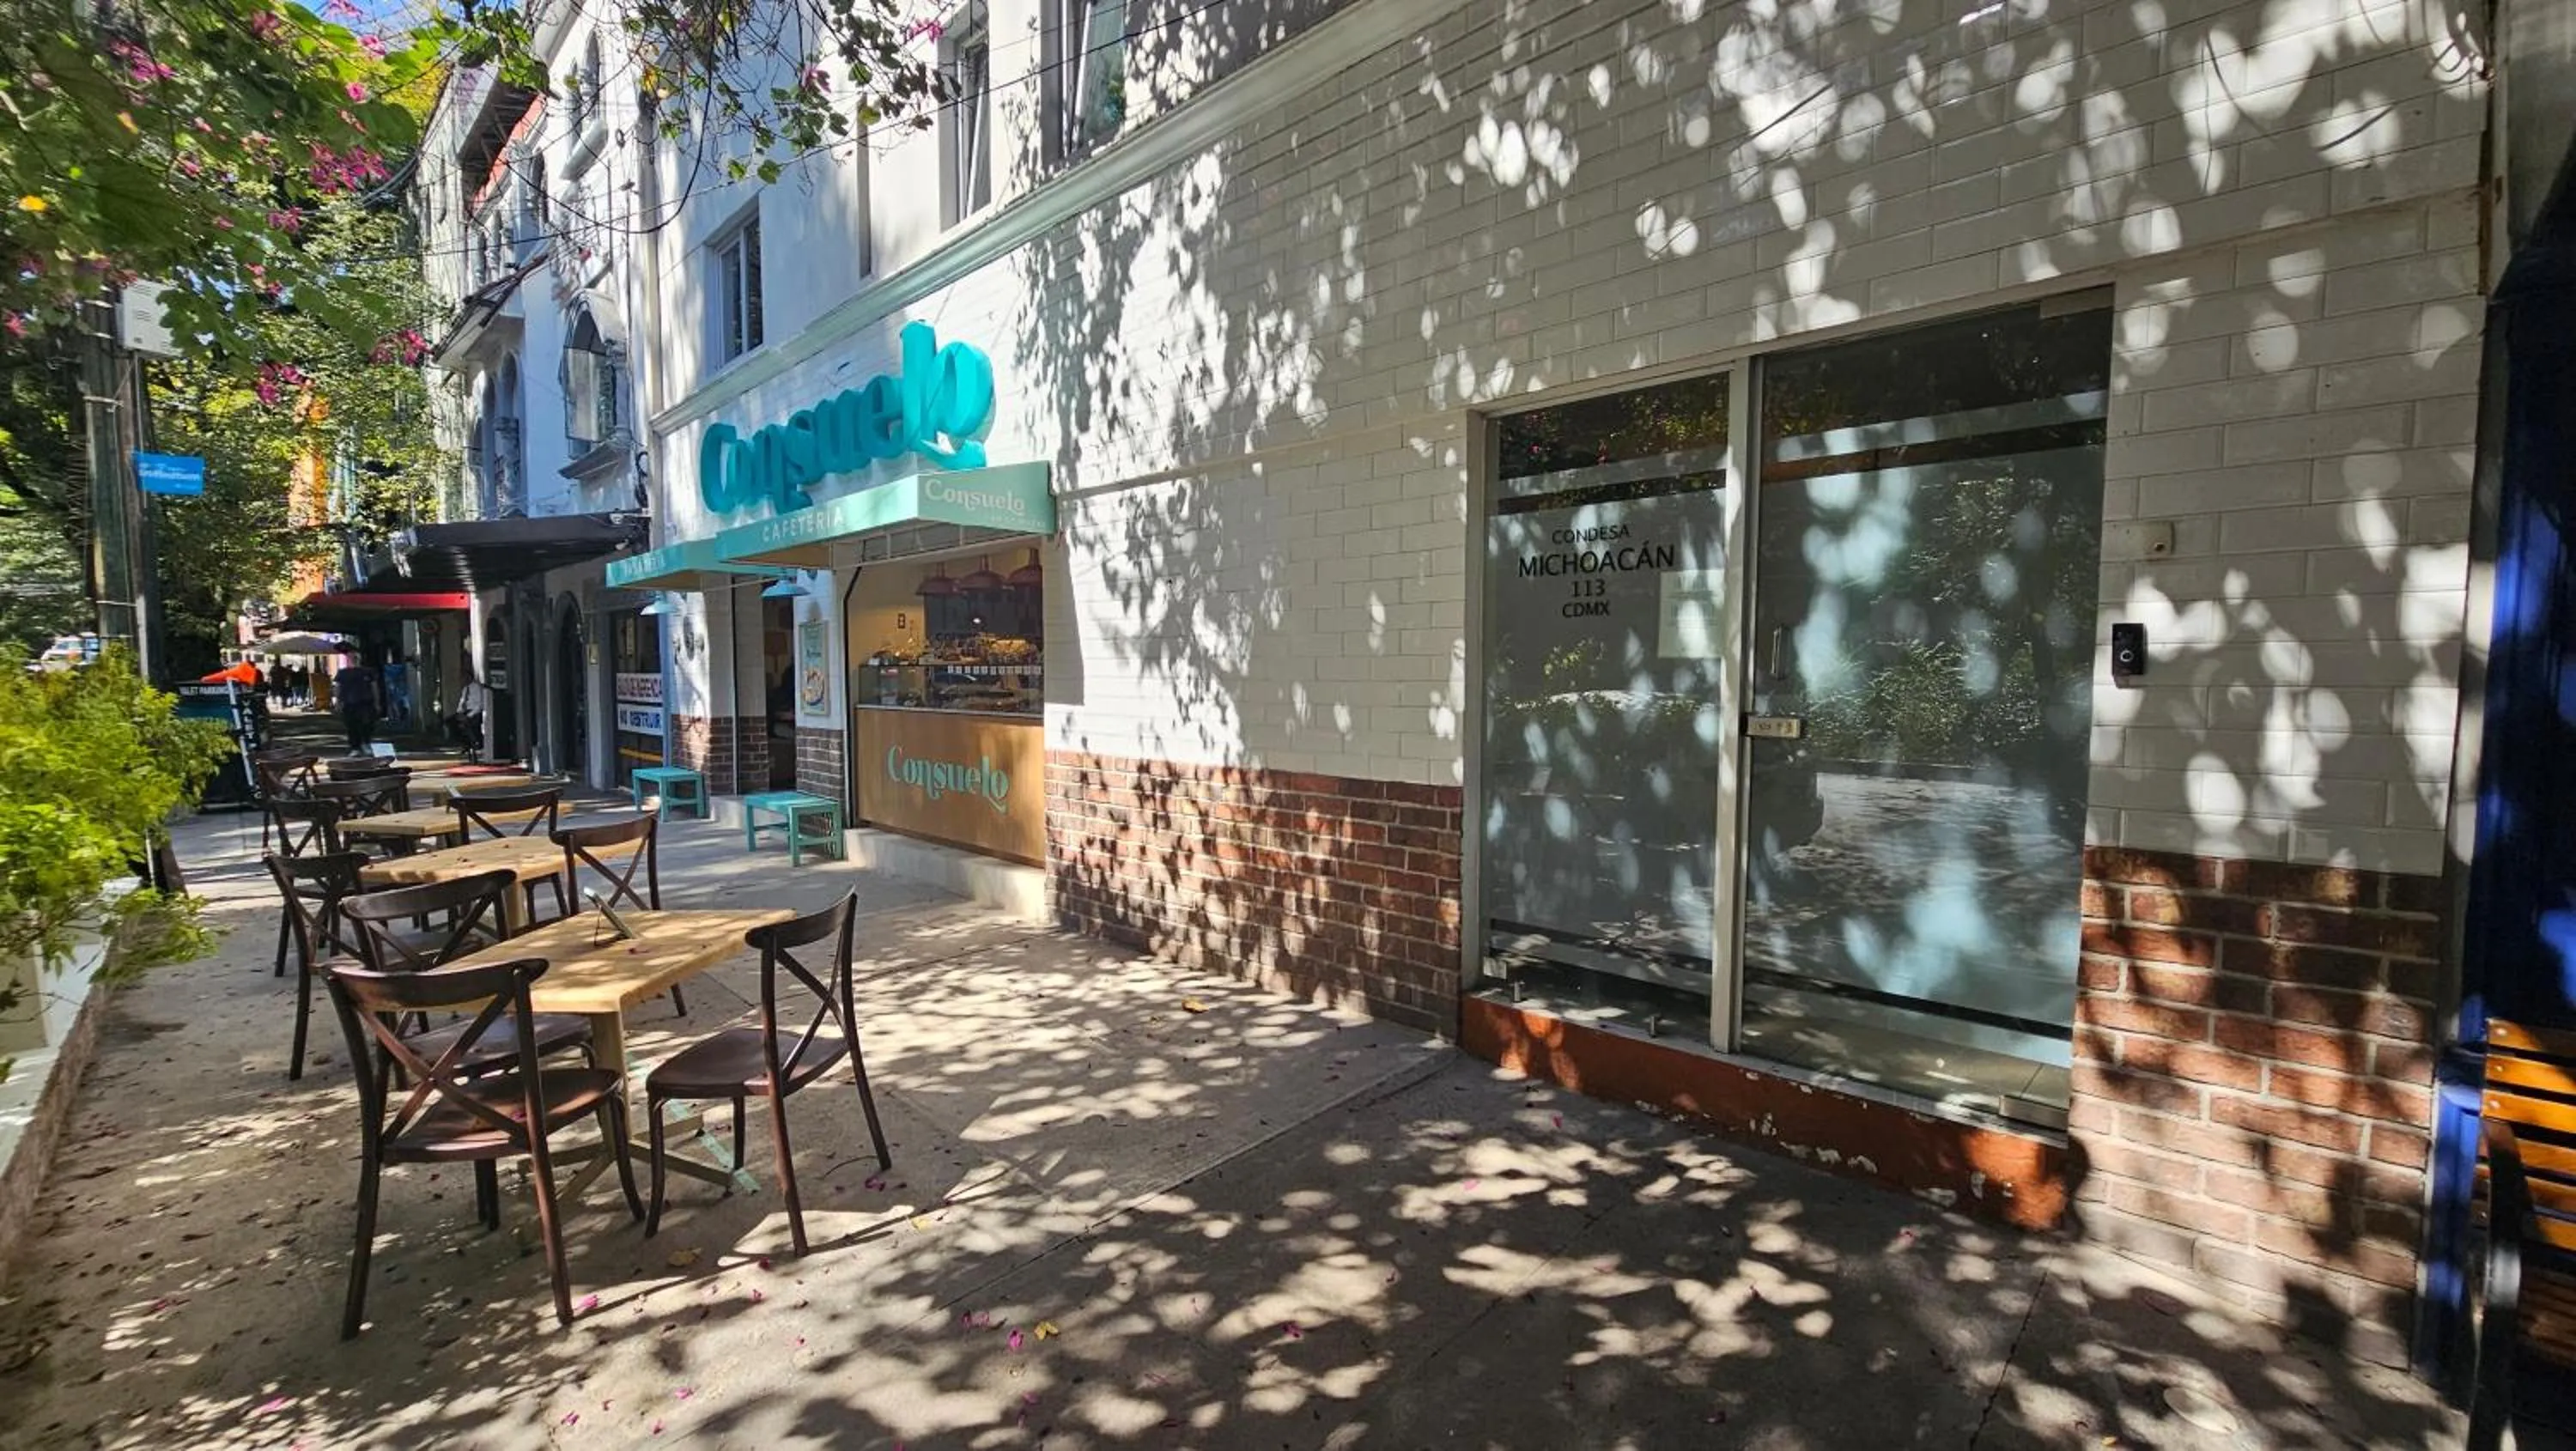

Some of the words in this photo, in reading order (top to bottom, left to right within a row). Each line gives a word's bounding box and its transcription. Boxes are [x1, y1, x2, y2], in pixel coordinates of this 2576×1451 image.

[701, 319, 997, 513] Consuelo
[925, 478, 1026, 516] Consuelo
[1552, 525, 1631, 544] CONDESA
[1519, 541, 1674, 577] MICHOACÁN
[1572, 579, 1606, 598] 113
[1562, 600, 1611, 617] CDMX
[888, 744, 1009, 814] Consuelo
